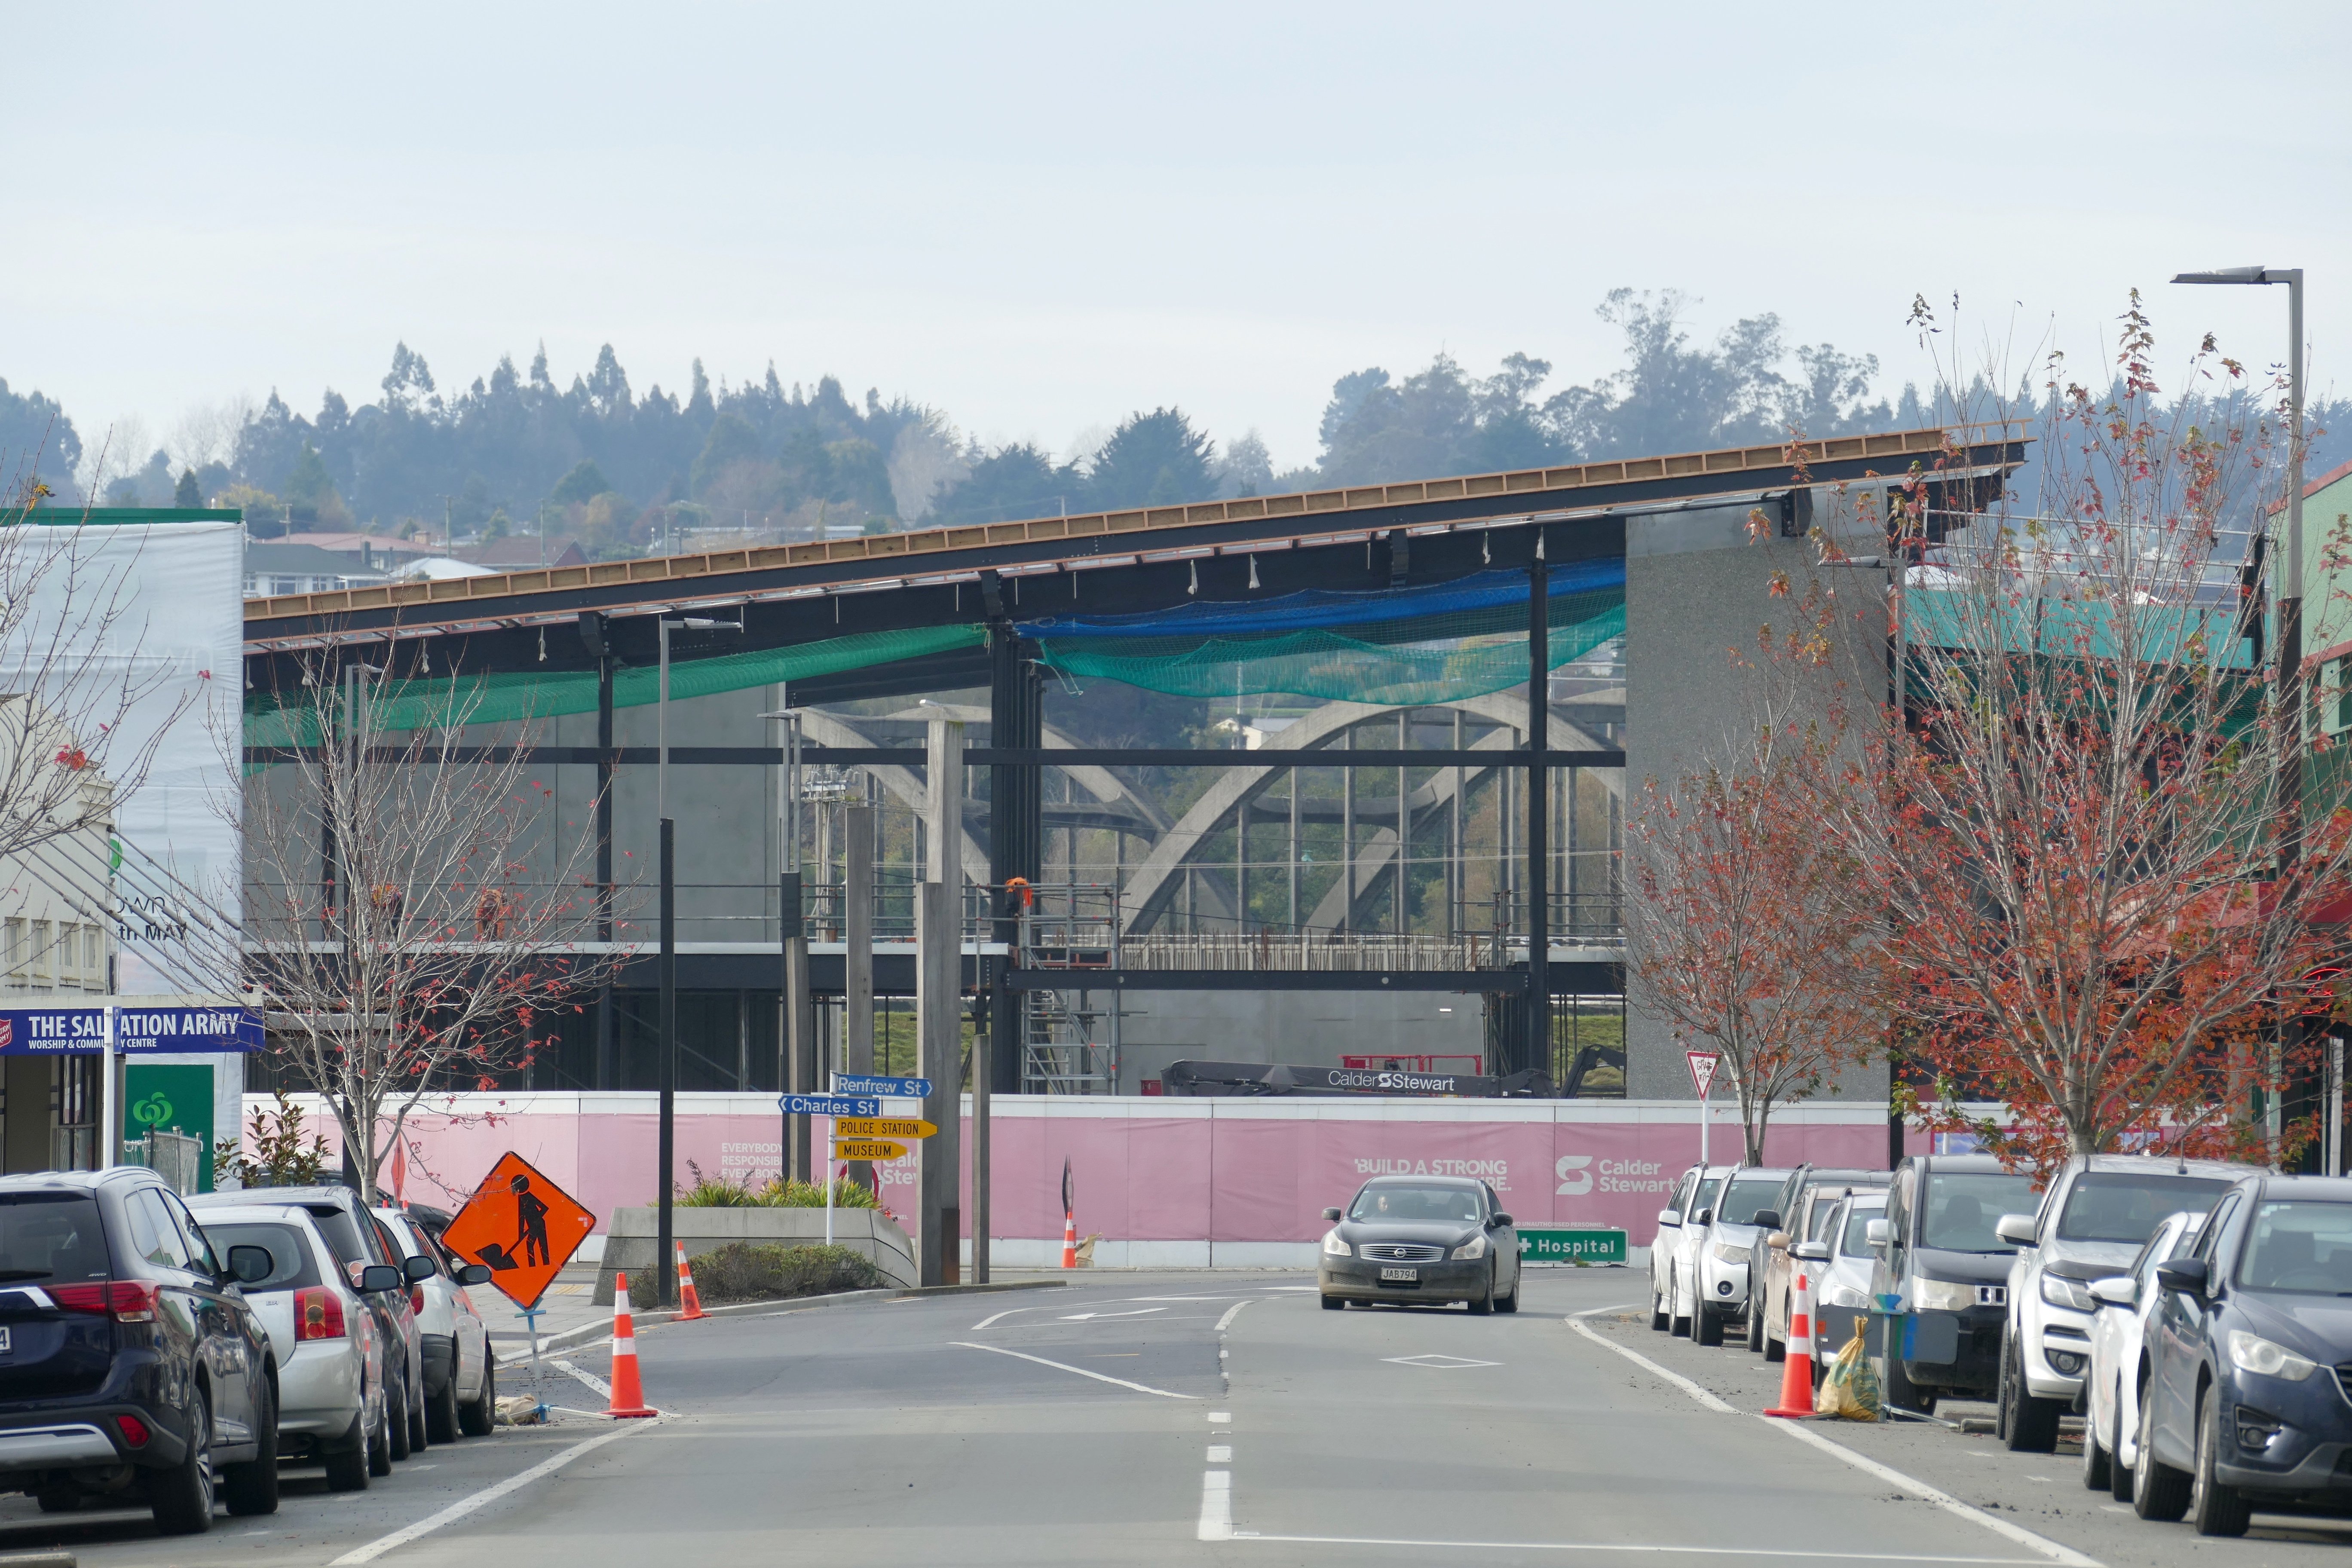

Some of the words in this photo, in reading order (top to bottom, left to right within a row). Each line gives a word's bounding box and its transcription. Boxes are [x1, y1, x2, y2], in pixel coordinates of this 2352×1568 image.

[28, 1016, 66, 1037] THE
[71, 1014, 176, 1037] SALATION
[181, 1014, 239, 1035] ARMY
[28, 1040, 67, 1049] WORSHIP
[67, 1039, 74, 1048] &
[76, 1038, 125, 1049] COMMUY
[126, 1038, 157, 1047] CENTRE
[838, 1077, 897, 1093] Renfrew
[904, 1080, 922, 1095] St
[1328, 1071, 1378, 1087] Calder
[1392, 1074, 1455, 1091] Stewart
[791, 1097, 850, 1113] Charles
[857, 1101, 875, 1115] St
[841, 1122, 874, 1133] POLICE
[882, 1123, 919, 1135] STATION
[844, 1145, 891, 1156] MUSEUM
[1355, 1158, 1411, 1174] BUILD
[1414, 1159, 1428, 1175] A
[1431, 1159, 1507, 1175] STRONG
[1599, 1159, 1662, 1175] Calder
[1599, 1176, 1676, 1192] Stewart
[1538, 1239, 1614, 1256] Hospital
[1383, 1270, 1415, 1279] JAB794
